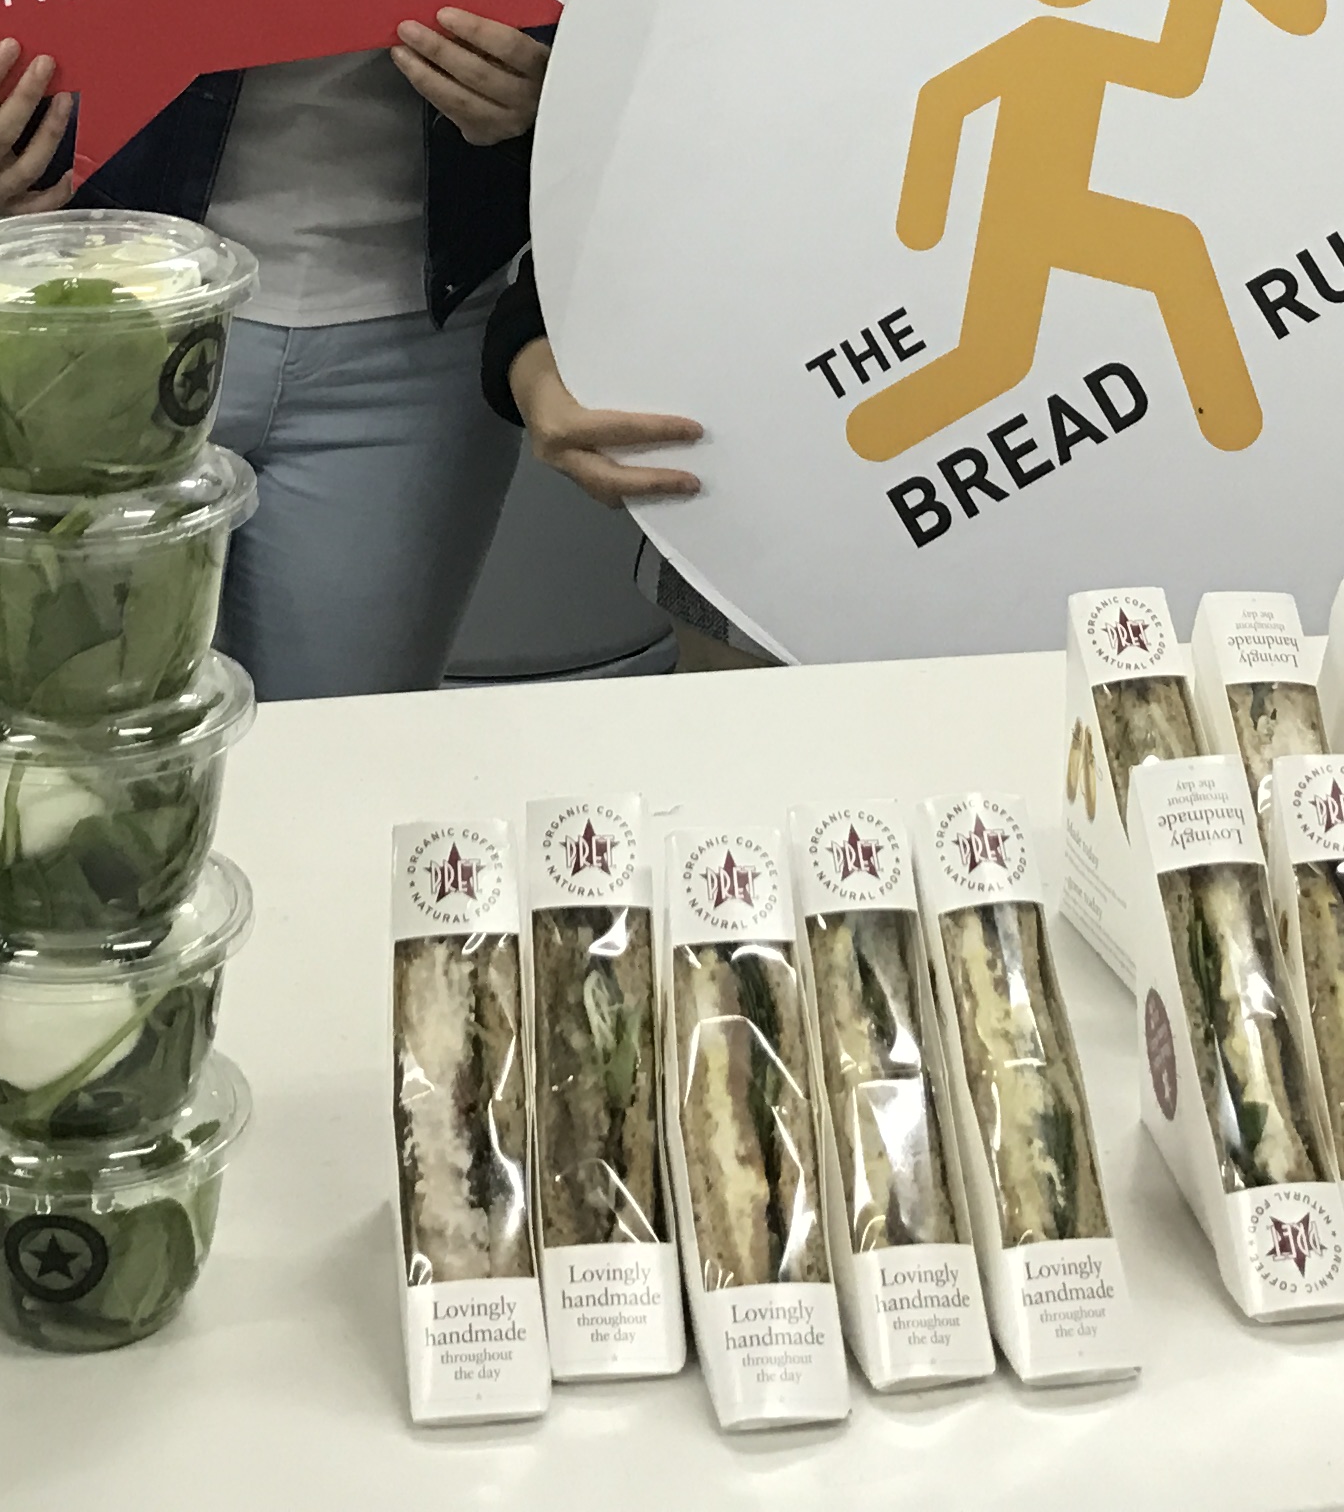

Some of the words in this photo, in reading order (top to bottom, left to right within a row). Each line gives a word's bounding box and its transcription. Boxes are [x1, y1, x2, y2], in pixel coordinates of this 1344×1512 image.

[804, 306, 927, 400] THE
[885, 361, 1150, 549] BREAD
[1087, 595, 1119, 635] ORGANIC
[1125, 596, 1162, 628] COFFEE
[1106, 619, 1152, 650] PRET
[1228, 635, 1300, 652] handmade
[1096, 647, 1147, 671] NATURAL
[1150, 640, 1167, 666] FOOD
[1239, 650, 1299, 669] Lovingly
[1293, 764, 1333, 807] ORGANIC
[543, 804, 590, 848] ORGANIC
[597, 806, 636, 846] COFFEE
[809, 809, 851, 854] ORGANIC
[858, 810, 900, 851] COFFEE
[1158, 808, 1245, 831] handmade
[407, 827, 454, 874] ORGANIC
[462, 828, 503, 870] COFFEE
[565, 835, 615, 869] PRET
[956, 829, 1007, 863] PRET
[1169, 827, 1243, 850] Lovingly
[683, 835, 729, 880] ORGANIC
[736, 837, 778, 878] COFFEE
[831, 840, 881, 872] PRET
[430, 859, 481, 895] PRET
[547, 866, 605, 897] NATURAL
[609, 863, 635, 892] FOOD
[706, 866, 757, 900] PRET
[817, 871, 876, 902] NATURAL
[879, 866, 902, 896] FOOD
[411, 892, 470, 923] NATURAL
[475, 887, 501, 917] FOOD
[689, 897, 748, 930] NATURAL
[753, 893, 778, 924] FOOD
[569, 1261, 651, 1285] Lovingly
[880, 1262, 958, 1286] Lovingly
[1024, 1255, 1103, 1280] Lovingly
[562, 1286, 661, 1310] handmade
[875, 1288, 971, 1313] handmade
[1022, 1280, 1115, 1307] handmade
[432, 1295, 517, 1320] Lovingly
[577, 1311, 647, 1328] throughout
[731, 1300, 815, 1325] Lovingly
[1039, 1307, 1106, 1324] throughout
[425, 1320, 527, 1347] handmade
[590, 1329, 610, 1343] the
[613, 1327, 636, 1343] day
[725, 1323, 825, 1350] handmade
[892, 1315, 960, 1331] throughout
[1054, 1324, 1075, 1338] the
[1076, 1322, 1098, 1338] day
[907, 1331, 927, 1346] the
[929, 1330, 951, 1346] day
[440, 1348, 513, 1364] throughout
[742, 1351, 812, 1368] throughout
[454, 1367, 474, 1381] the
[477, 1365, 501, 1381] day
[756, 1369, 776, 1383] the
[779, 1367, 802, 1383] day
